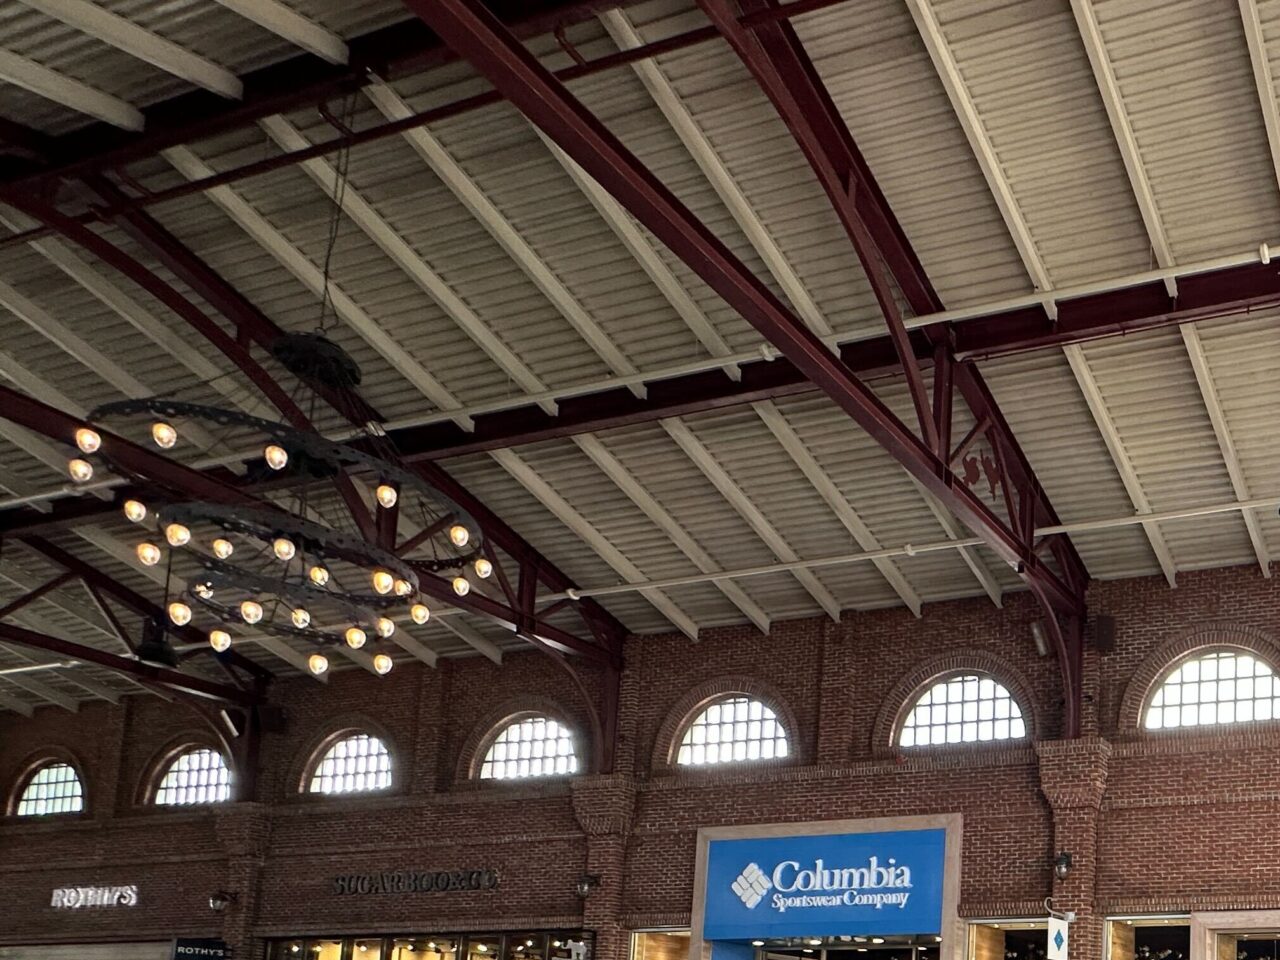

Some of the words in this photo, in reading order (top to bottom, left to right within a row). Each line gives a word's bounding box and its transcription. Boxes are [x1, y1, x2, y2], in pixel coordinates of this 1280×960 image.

[772, 856, 913, 892] Columbia
[51, 885, 138, 909] ROTHY'S
[771, 893, 843, 912] Sportswear
[843, 890, 910, 909] Company
[177, 946, 224, 957] ROTHY'S
